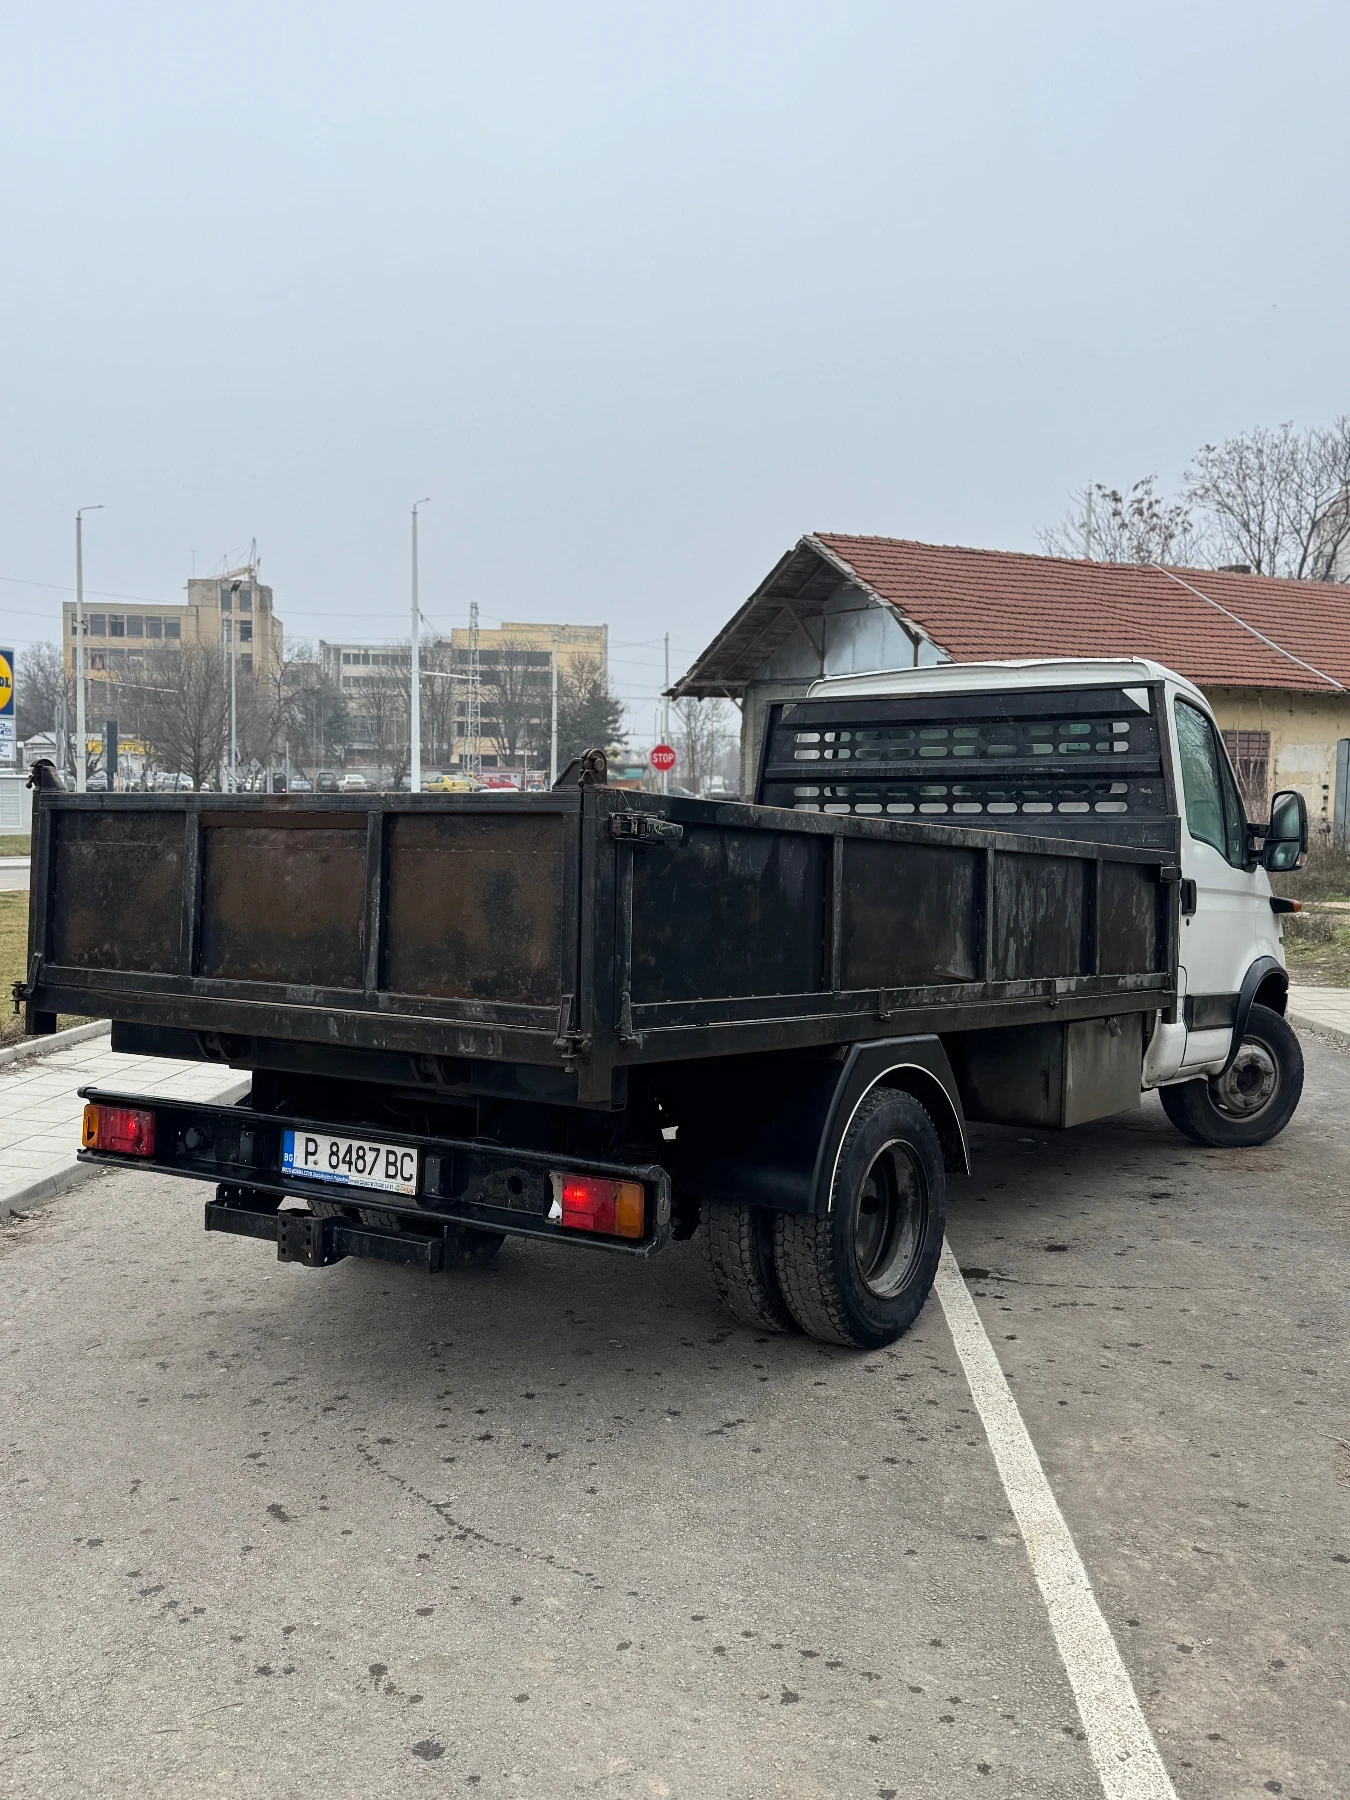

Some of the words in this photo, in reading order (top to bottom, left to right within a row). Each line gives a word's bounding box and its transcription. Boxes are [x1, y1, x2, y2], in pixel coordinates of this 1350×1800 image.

[652, 753, 674, 763] STOP
[304, 1136, 318, 1166] P
[284, 1152, 294, 1162] BG
